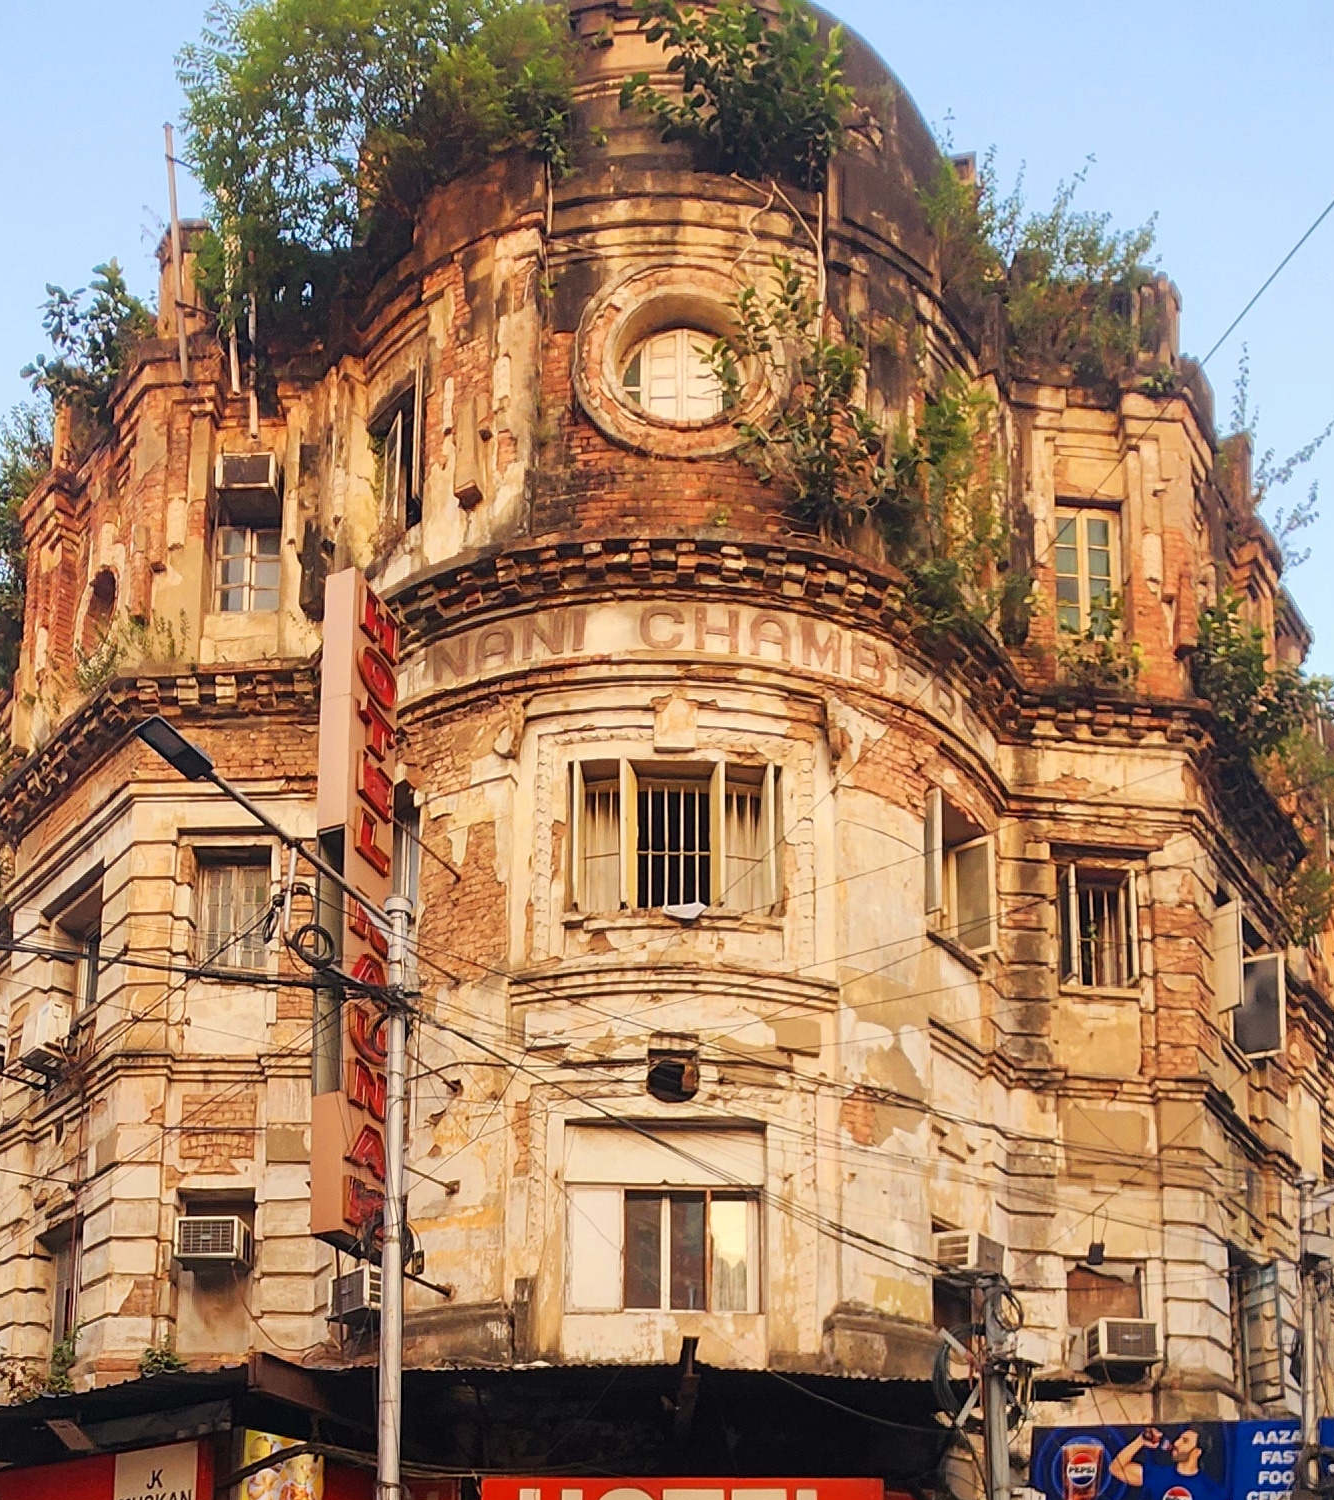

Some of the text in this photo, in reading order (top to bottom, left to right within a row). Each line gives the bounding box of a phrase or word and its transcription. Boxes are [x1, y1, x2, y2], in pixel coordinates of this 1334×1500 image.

[357, 574, 399, 878] HOTEL
[1252, 1430, 1305, 1445] AAZA
[146, 1469, 163, 1490] JK
[1258, 1470, 1296, 1485] FOO
